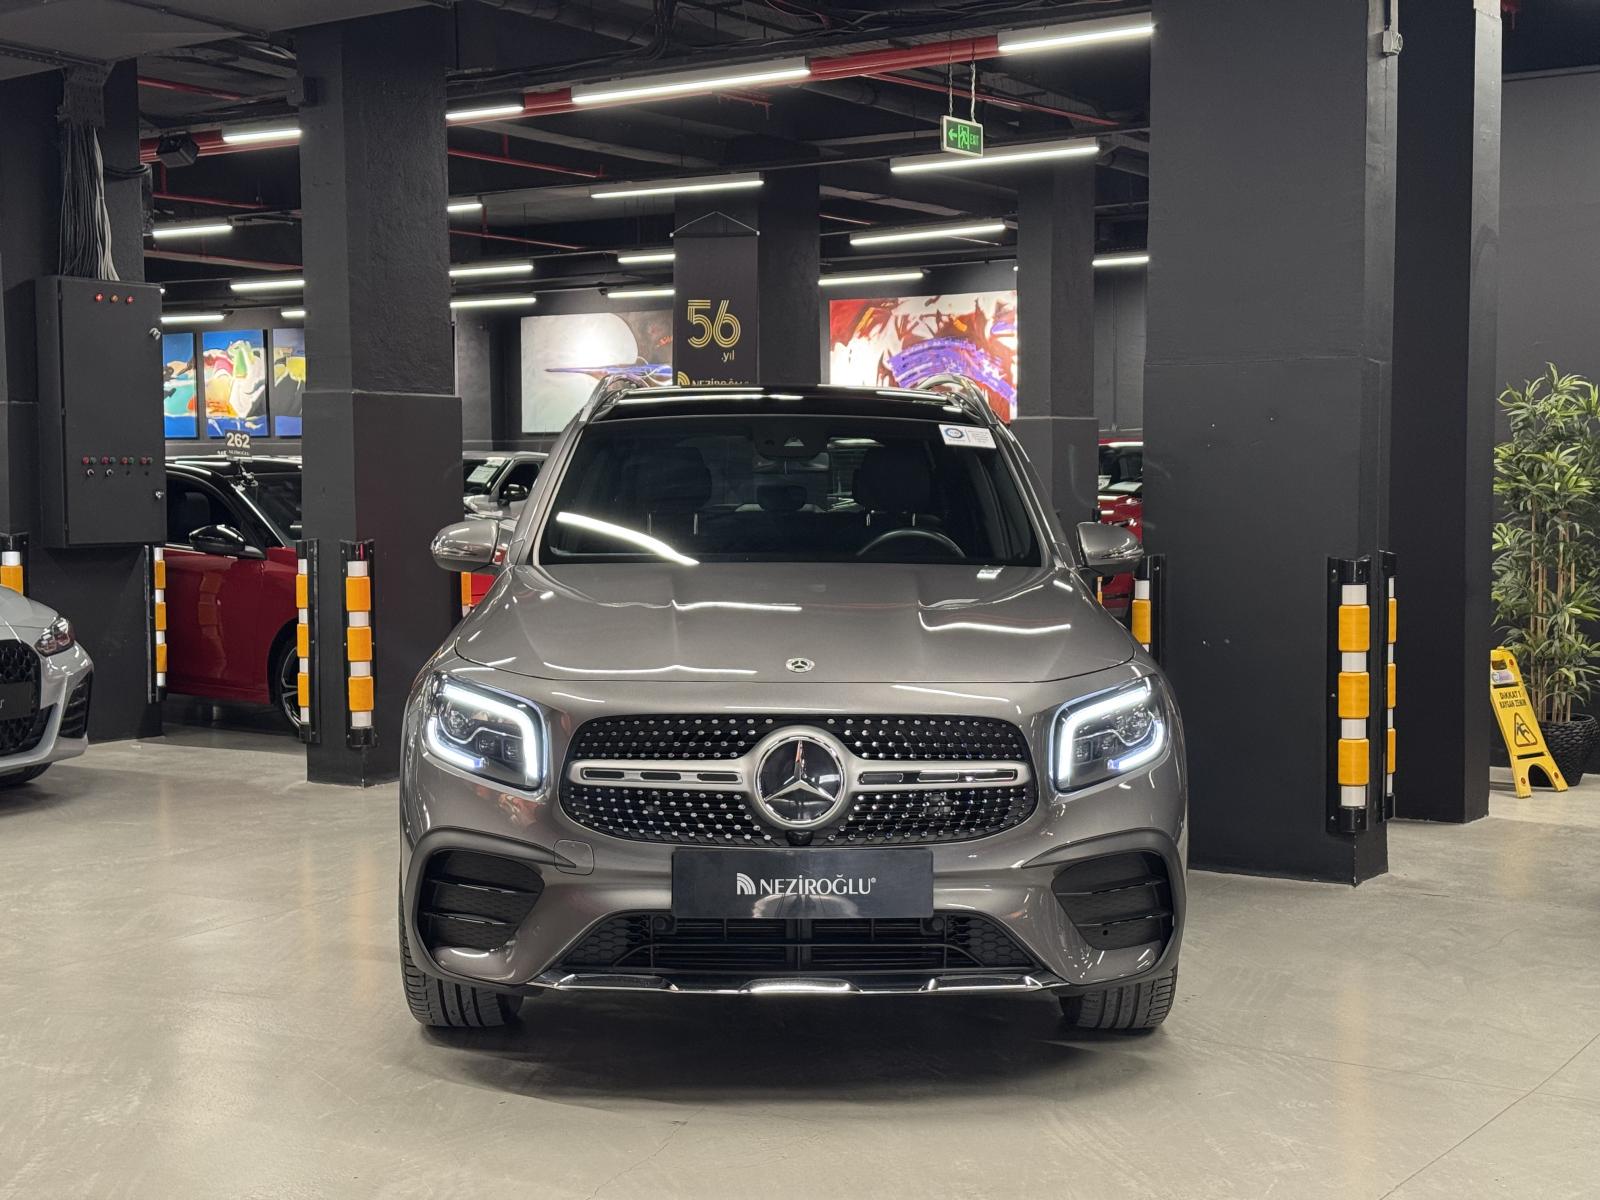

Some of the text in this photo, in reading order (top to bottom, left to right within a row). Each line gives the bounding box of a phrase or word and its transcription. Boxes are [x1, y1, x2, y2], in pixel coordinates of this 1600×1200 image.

[687, 299, 741, 348] 56
[226, 432, 251, 449] 262
[760, 873, 872, 895] NEZİROĞLU
